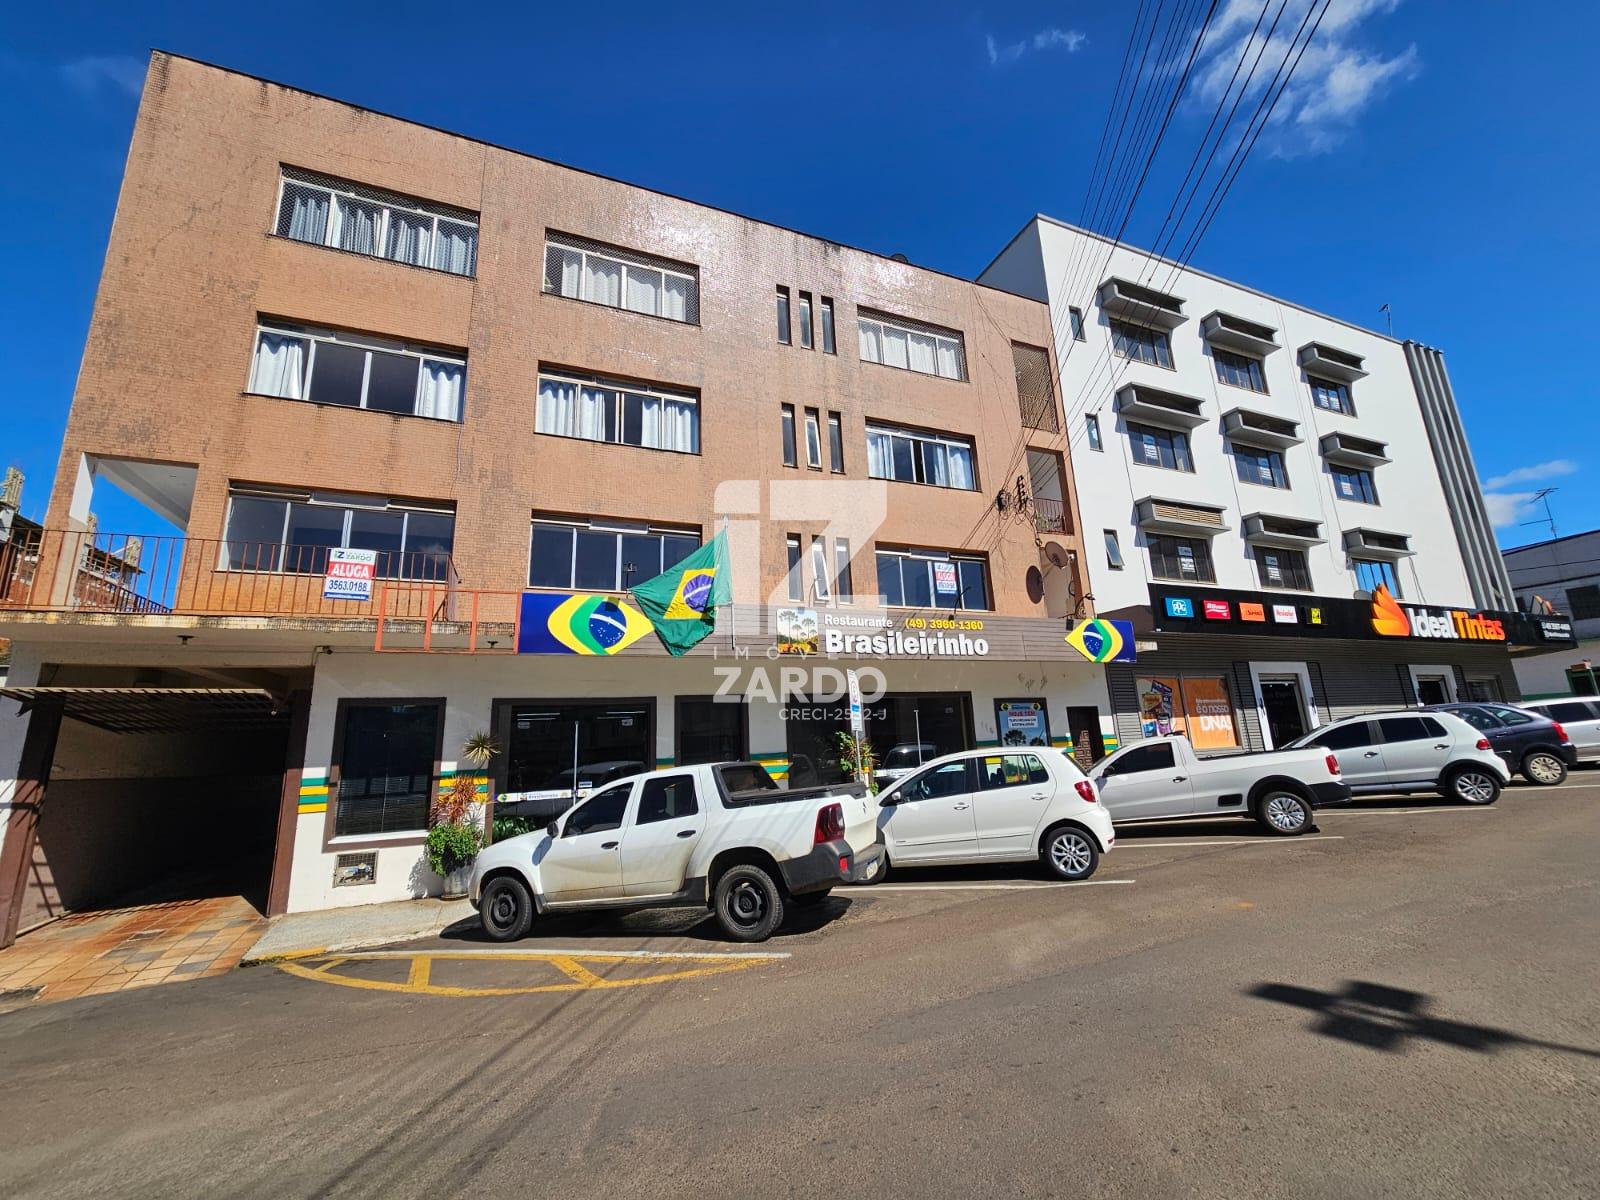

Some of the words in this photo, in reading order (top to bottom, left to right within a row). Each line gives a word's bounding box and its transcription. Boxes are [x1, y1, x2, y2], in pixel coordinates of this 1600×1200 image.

[331, 563, 369, 579] ALUGA
[329, 579, 368, 591] 3563.0188
[824, 613, 893, 628] Restaurante
[905, 618, 927, 630] (49)
[825, 629, 989, 656] Brasileirinho
